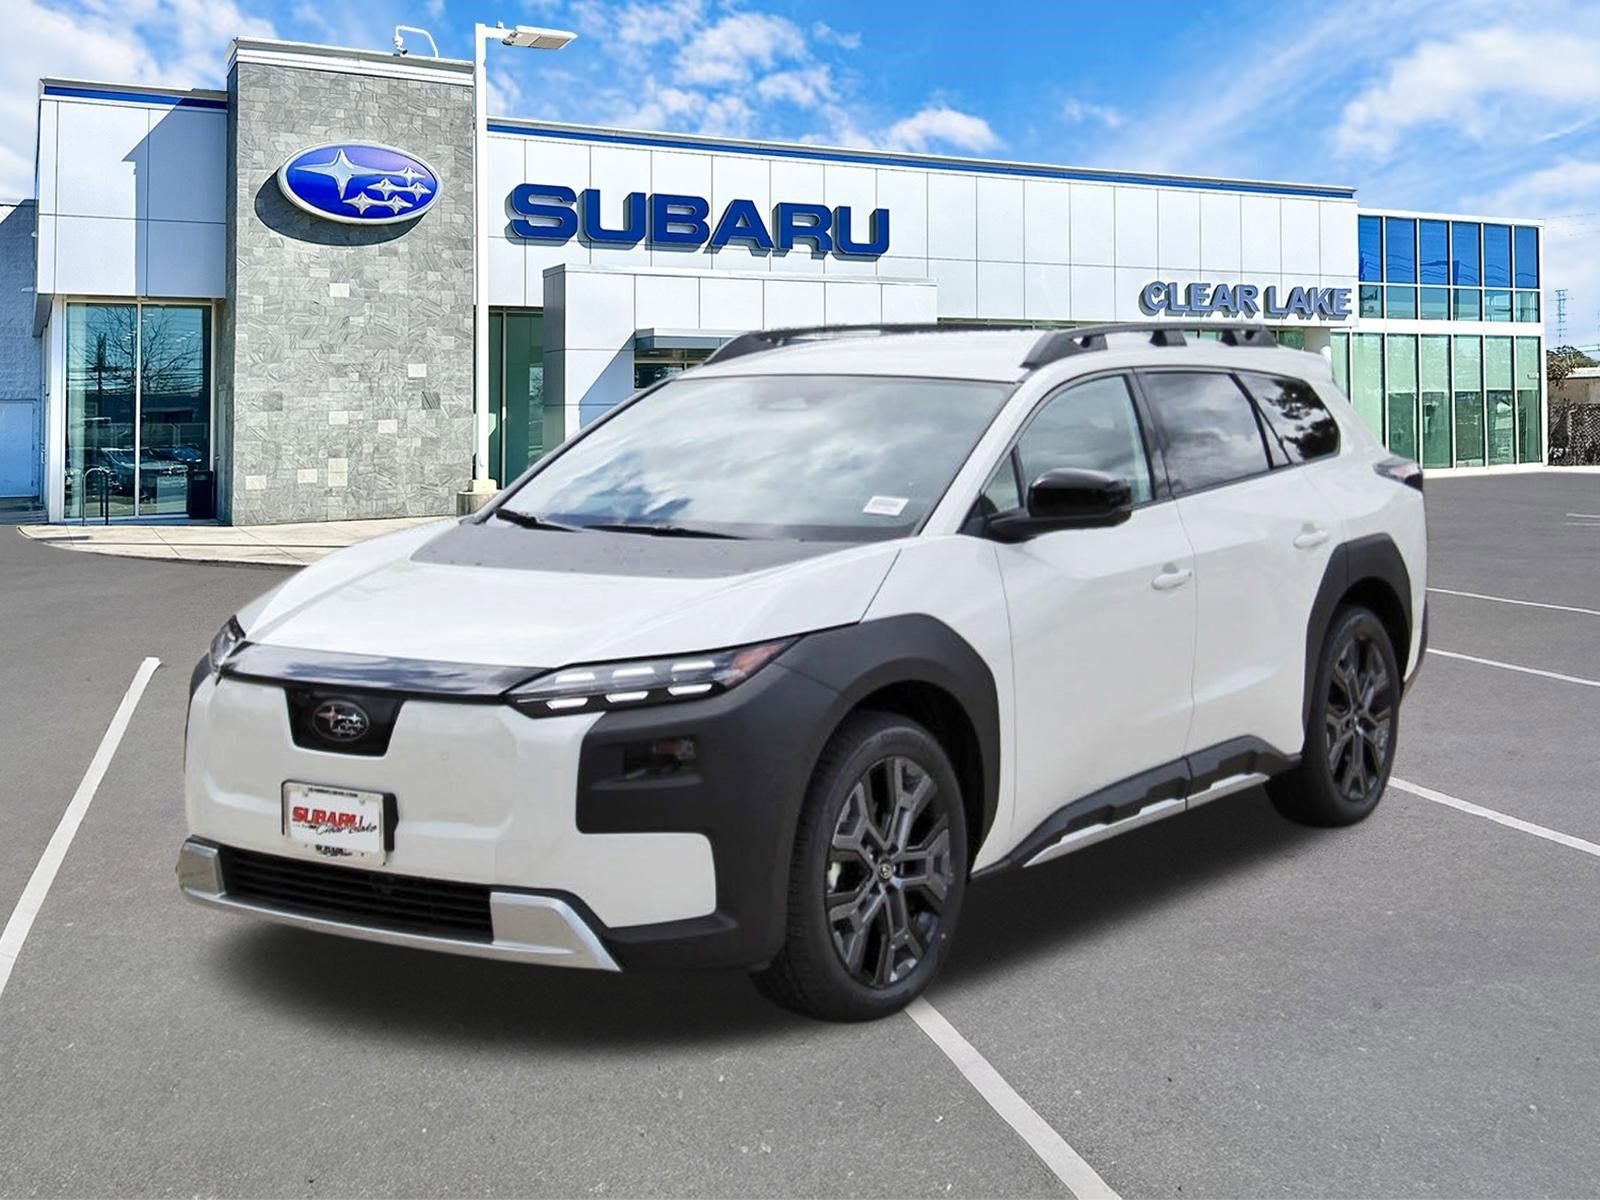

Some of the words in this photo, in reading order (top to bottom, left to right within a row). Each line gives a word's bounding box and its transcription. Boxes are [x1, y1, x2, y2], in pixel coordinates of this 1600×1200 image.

[505, 183, 890, 261] SUBARU
[1139, 281, 1260, 319] CLEAR
[1263, 285, 1353, 321] LAKE
[292, 806, 358, 829] SUBARU
